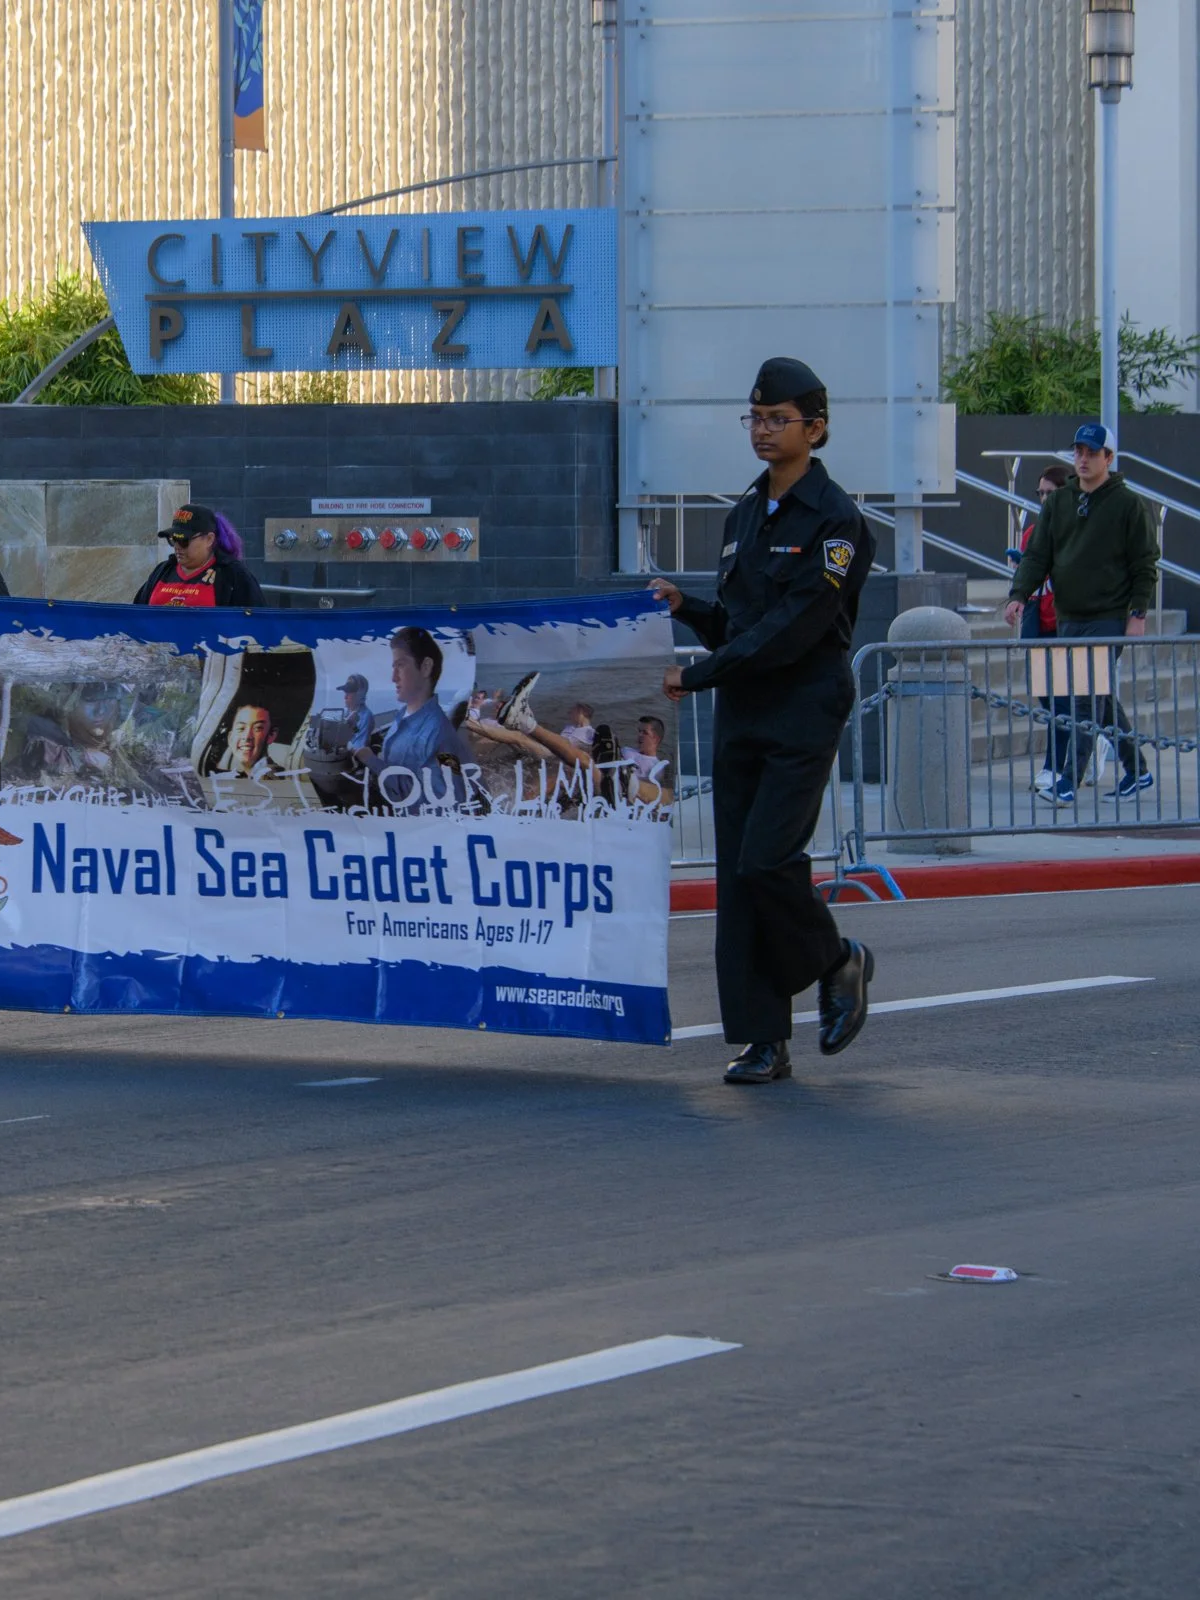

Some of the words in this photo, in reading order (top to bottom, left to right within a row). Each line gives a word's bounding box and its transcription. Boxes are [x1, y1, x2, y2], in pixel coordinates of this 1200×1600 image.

[146, 223, 574, 288] CITYVIEW
[149, 299, 574, 360] PLAZA
[159, 759, 313, 815] TEST
[340, 763, 494, 809] YOUR
[514, 757, 671, 806] LIMITS
[31, 822, 176, 896] Naval
[194, 827, 288, 899] Sea
[303, 829, 453, 905] Cadet
[466, 834, 613, 928] Corps
[346, 911, 376, 936] For
[383, 912, 469, 941] Americans
[475, 916, 514, 947] Ages
[519, 918, 553, 945] 11-17
[495, 984, 625, 1017] www.seacadets.org
